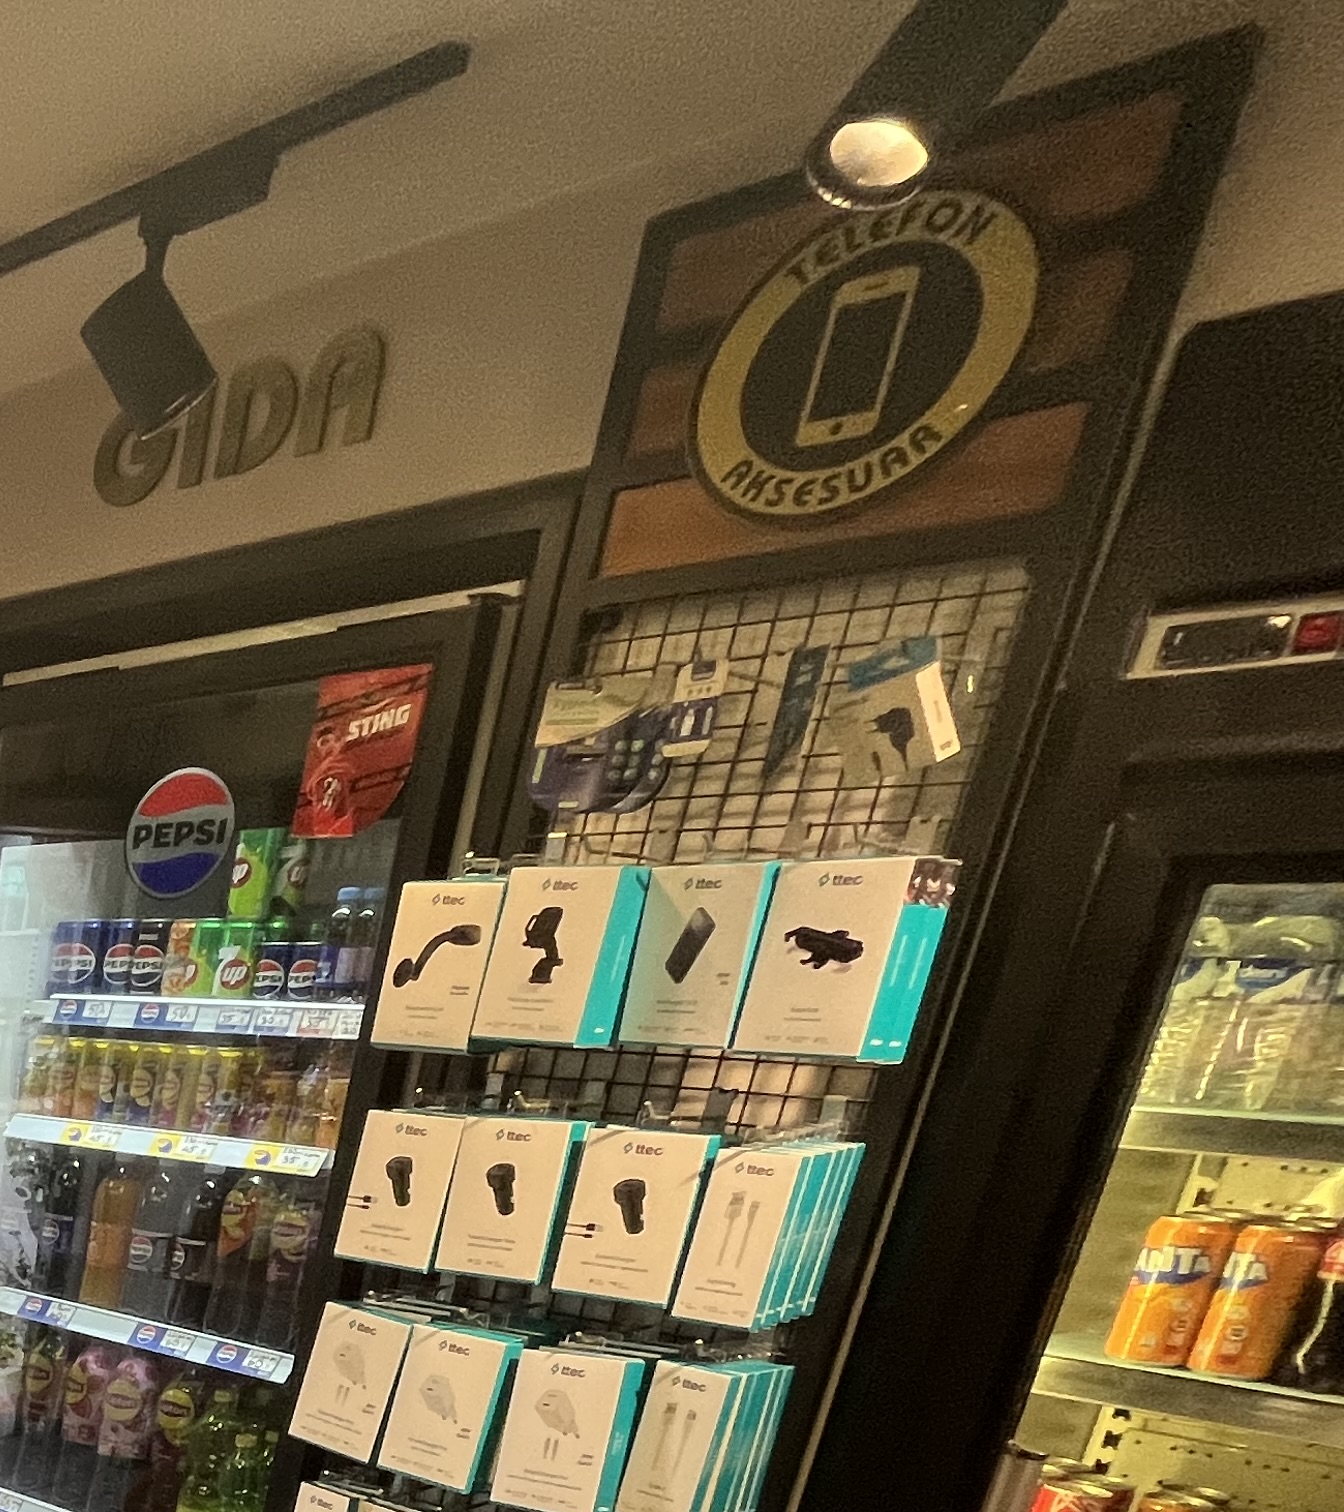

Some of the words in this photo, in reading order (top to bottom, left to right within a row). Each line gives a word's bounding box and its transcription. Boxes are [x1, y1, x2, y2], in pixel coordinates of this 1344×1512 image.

[784, 195, 997, 288] TELEFON
[91, 325, 386, 508] GIDA
[720, 422, 945, 511] AKSESUAR
[346, 703, 412, 744] STING
[131, 816, 226, 852] PEPSI
[553, 879, 578, 892] ttec
[696, 877, 722, 889] ttec
[832, 874, 863, 887] ttec
[507, 1130, 532, 1143] ttec
[635, 1143, 663, 1157] ttec
